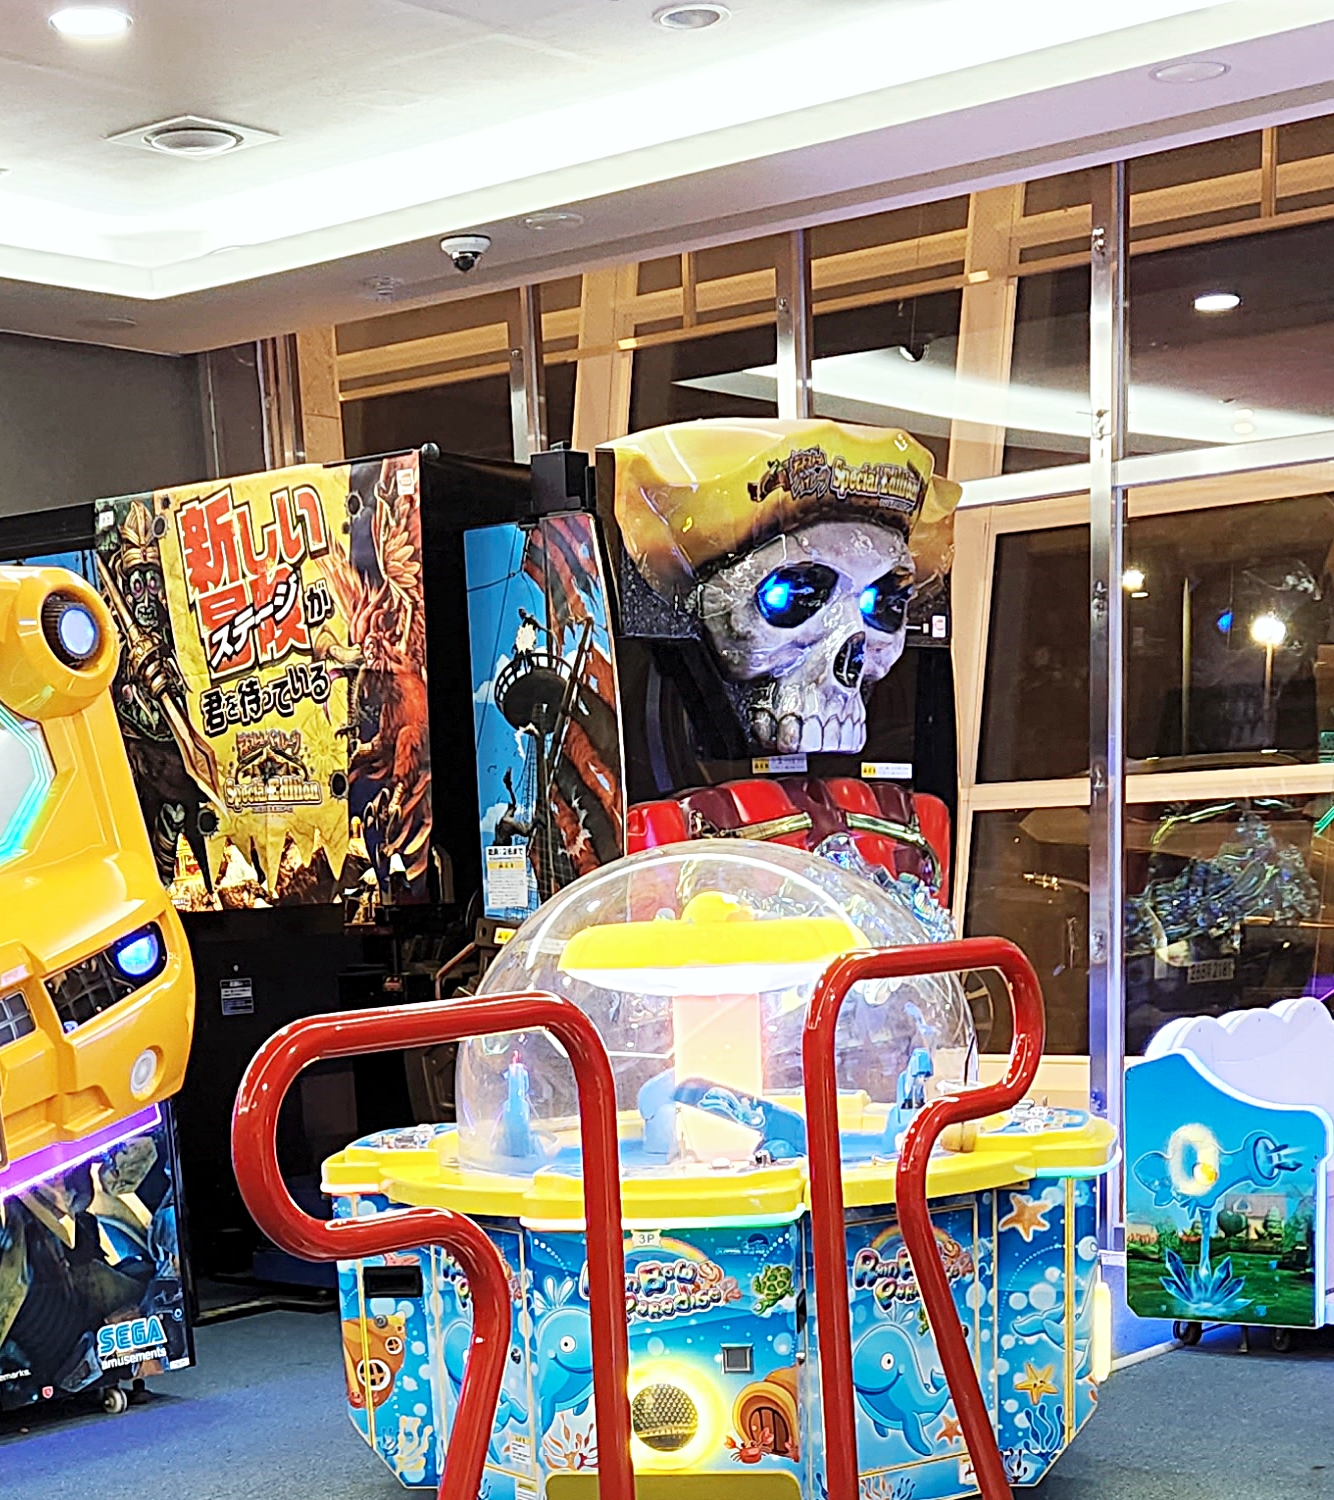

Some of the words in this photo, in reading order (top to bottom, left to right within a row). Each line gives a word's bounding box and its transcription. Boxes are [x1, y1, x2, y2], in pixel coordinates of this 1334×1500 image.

[177, 484, 328, 605] 新しい
[201, 661, 331, 737] 君を待っている
[638, 1233, 655, 1245] 3P
[97, 1314, 168, 1357] SEGA
[101, 1347, 168, 1370] amusements
